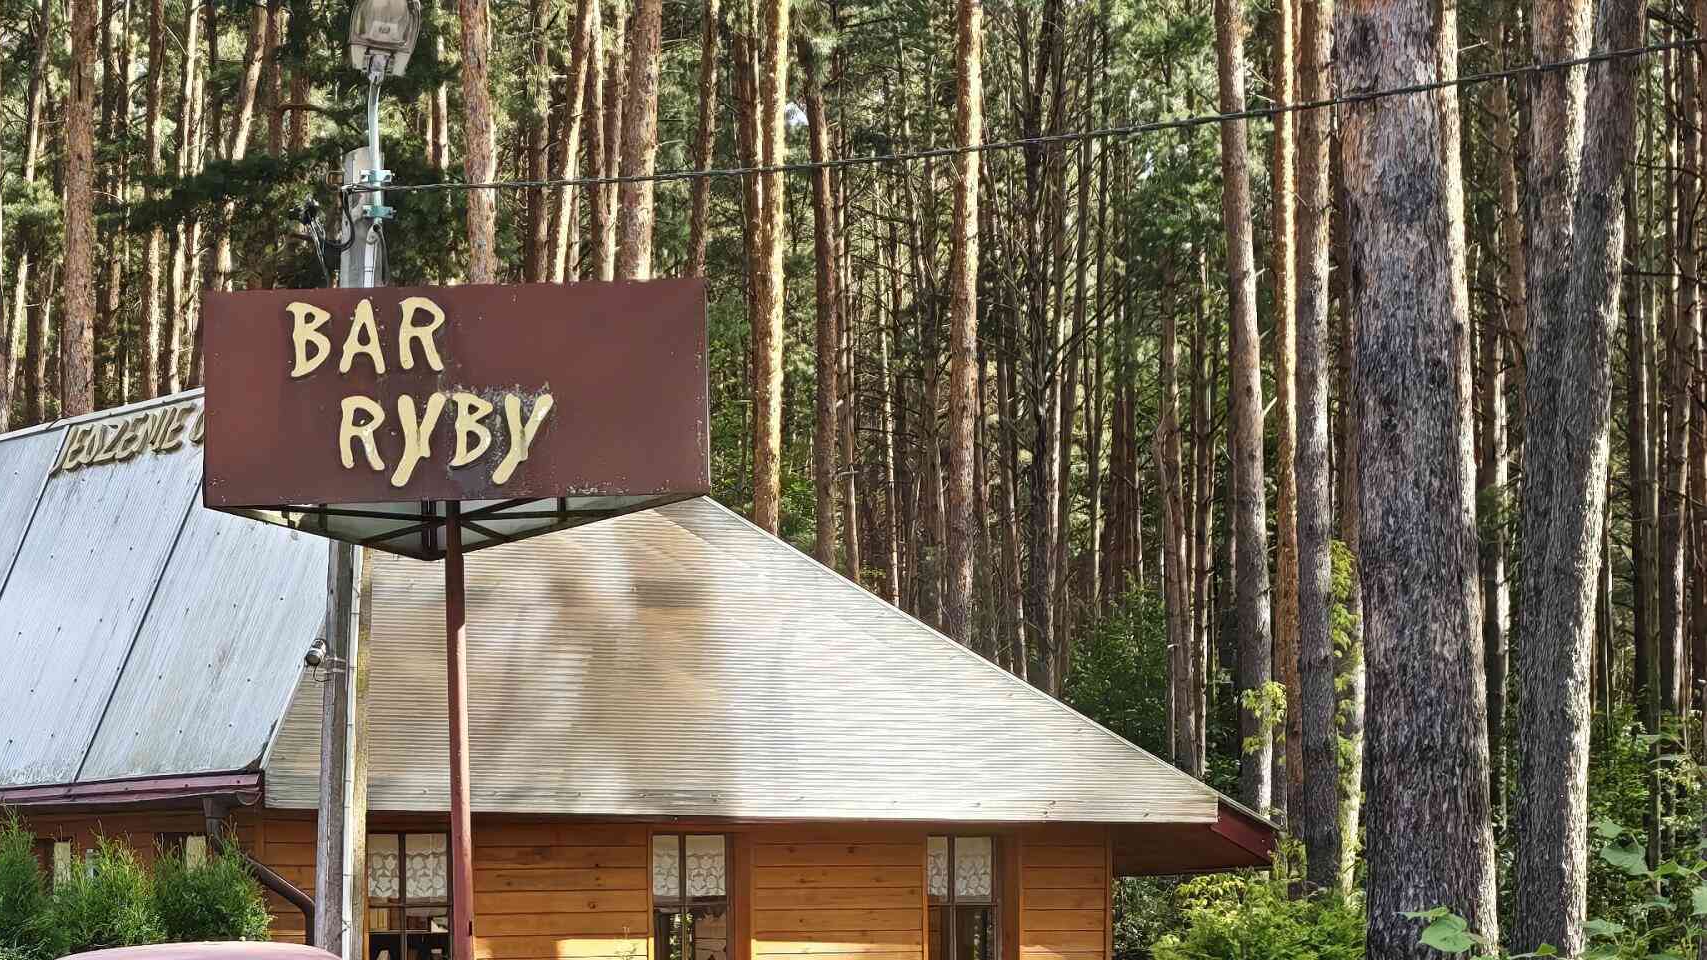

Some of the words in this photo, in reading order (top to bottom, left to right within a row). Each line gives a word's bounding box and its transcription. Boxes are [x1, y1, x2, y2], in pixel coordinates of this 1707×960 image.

[285, 296, 446, 377] BAR
[49, 402, 197, 476] JEDZENIE
[339, 391, 554, 487] RYBY
